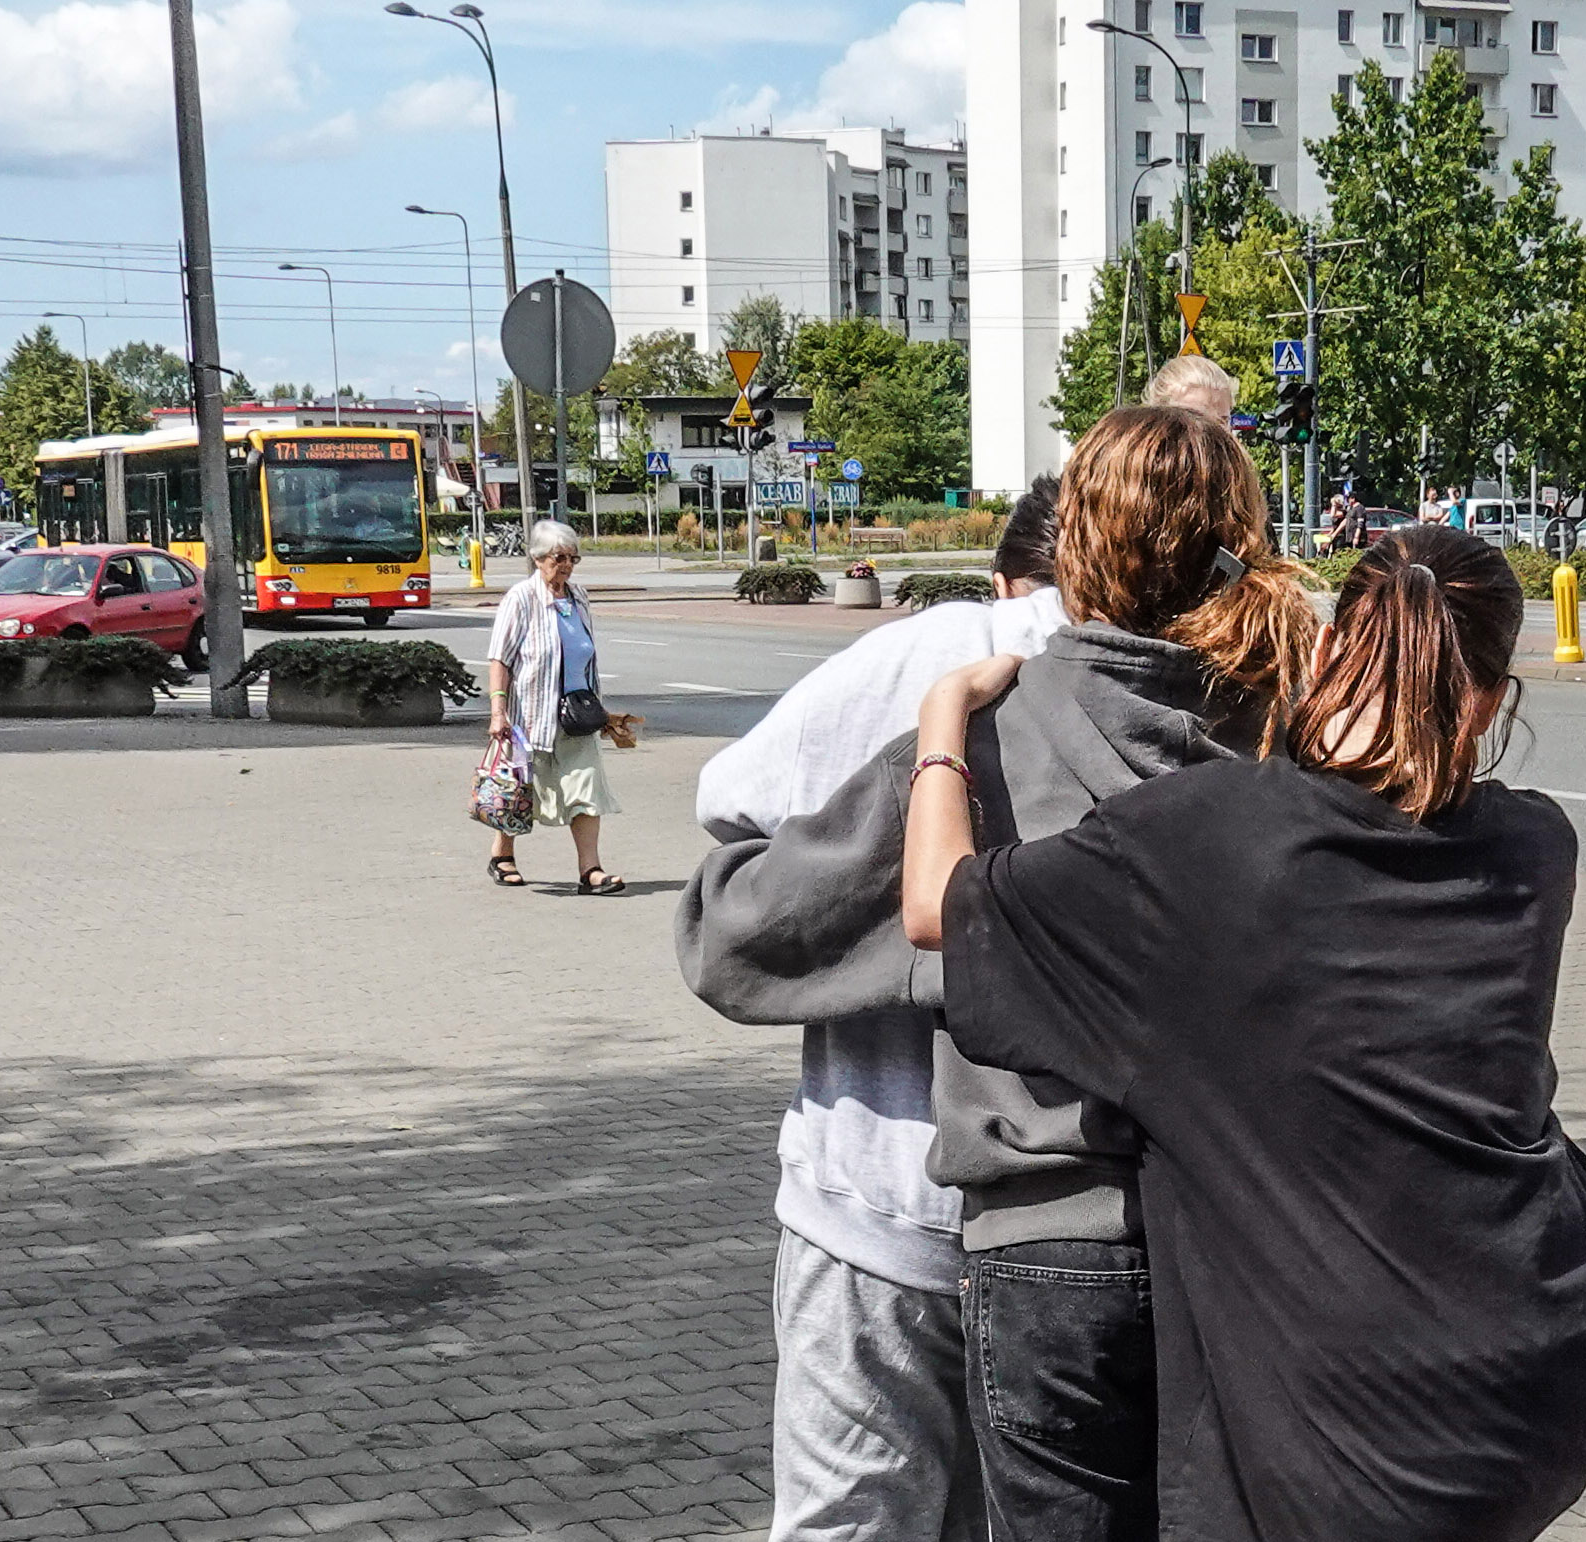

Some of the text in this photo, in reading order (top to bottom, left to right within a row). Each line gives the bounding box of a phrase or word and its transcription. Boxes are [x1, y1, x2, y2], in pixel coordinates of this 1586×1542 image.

[274, 443, 299, 460] 171
[757, 483, 802, 502] KEBAB
[834, 484, 857, 502] EBAB
[376, 565, 401, 575] 9818
